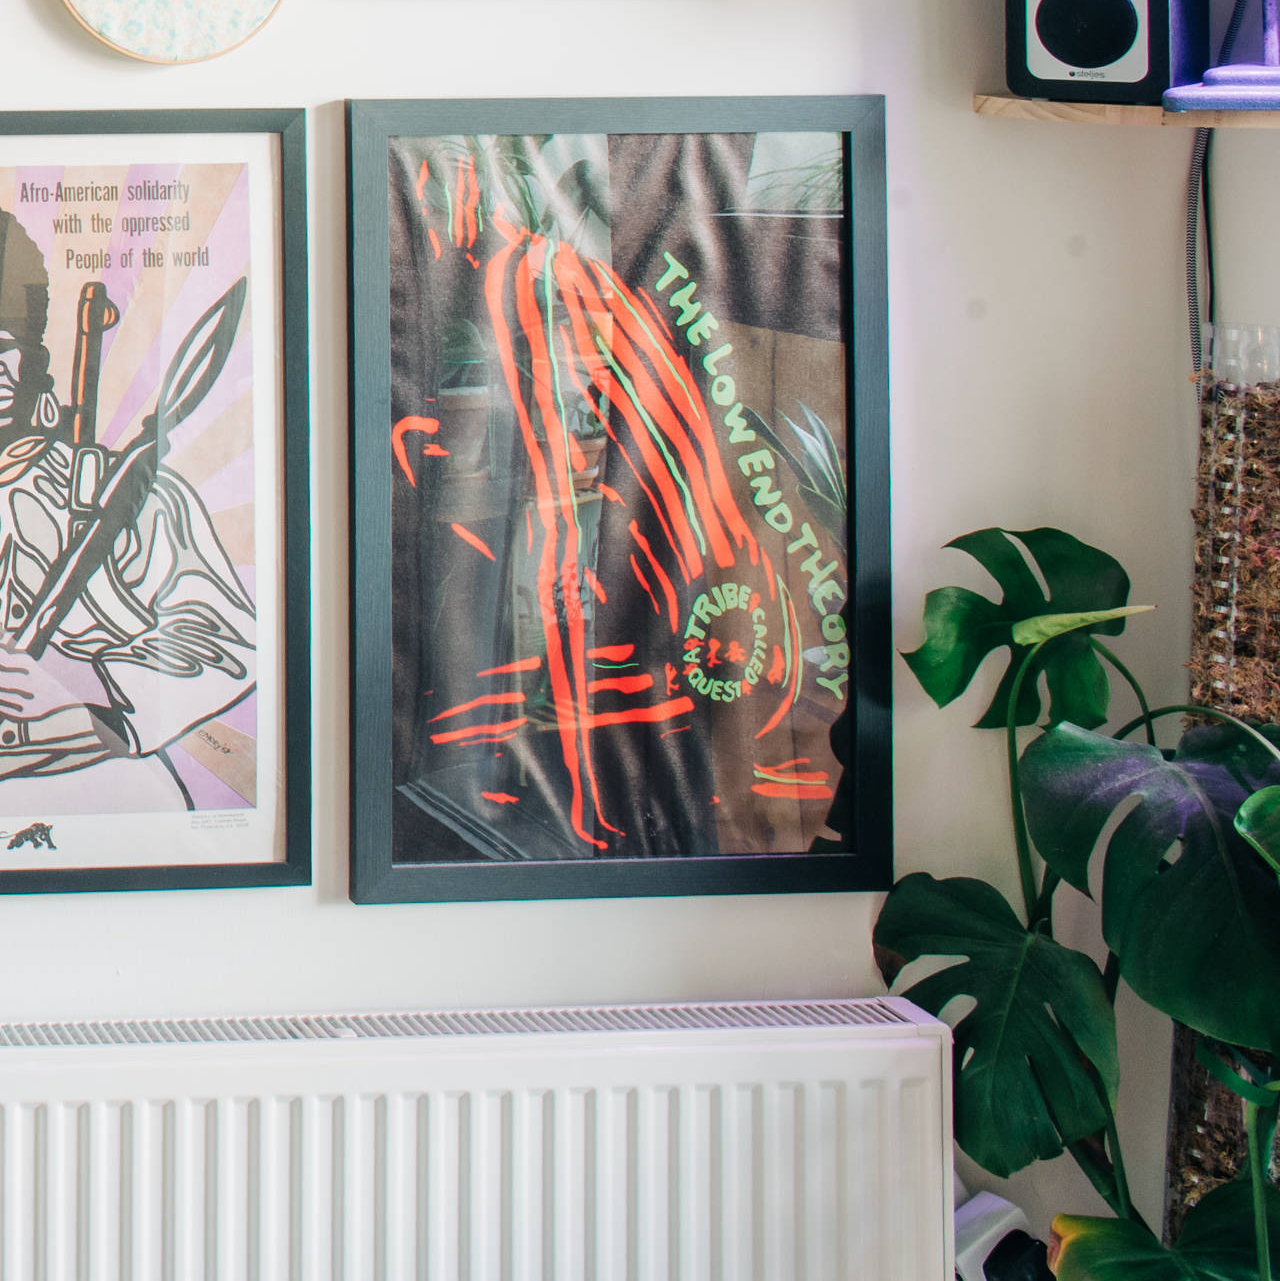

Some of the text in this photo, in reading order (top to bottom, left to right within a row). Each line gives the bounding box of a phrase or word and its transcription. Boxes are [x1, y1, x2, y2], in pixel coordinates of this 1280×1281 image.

[21, 180, 189, 202] Afro-American solidarity
[53, 212, 189, 236] with the oppressed
[66, 247, 209, 272] People of the world
[655, 251, 850, 700] THE LOW END THEORY
[682, 582, 767, 702] A TRIBE CALLED QUEST
